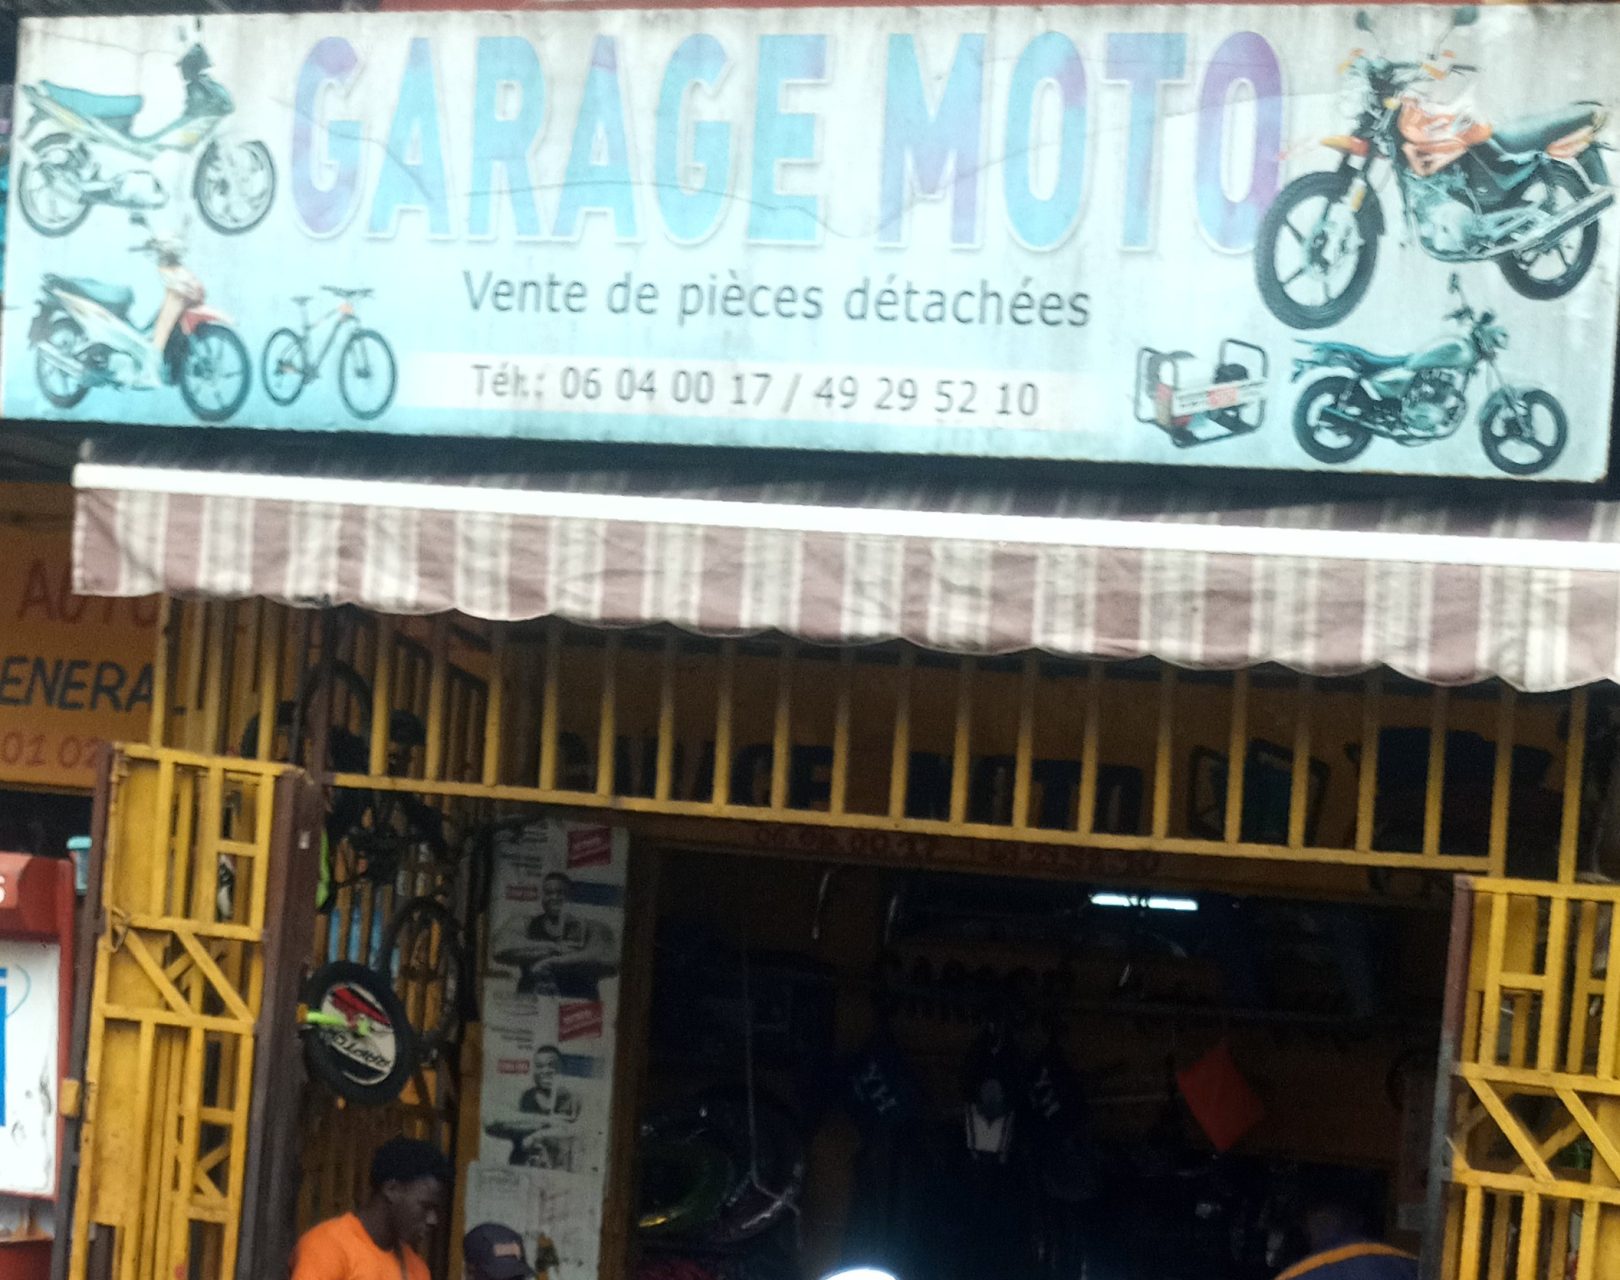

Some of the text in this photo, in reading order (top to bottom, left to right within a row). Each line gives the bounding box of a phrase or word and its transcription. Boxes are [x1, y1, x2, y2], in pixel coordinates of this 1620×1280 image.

[291, 31, 1283, 250] GARAGE MOTO
[463, 268, 1091, 327] Vente de pièces détachées
[560, 366, 602, 400] 06
[615, 367, 657, 402] 04
[671, 369, 714, 404] 00
[731, 371, 772, 407] 17
[781, 373, 802, 414] /
[812, 375, 859, 410] 49
[875, 376, 919, 412] 29
[933, 379, 979, 415] 52
[996, 381, 1039, 417] 10
